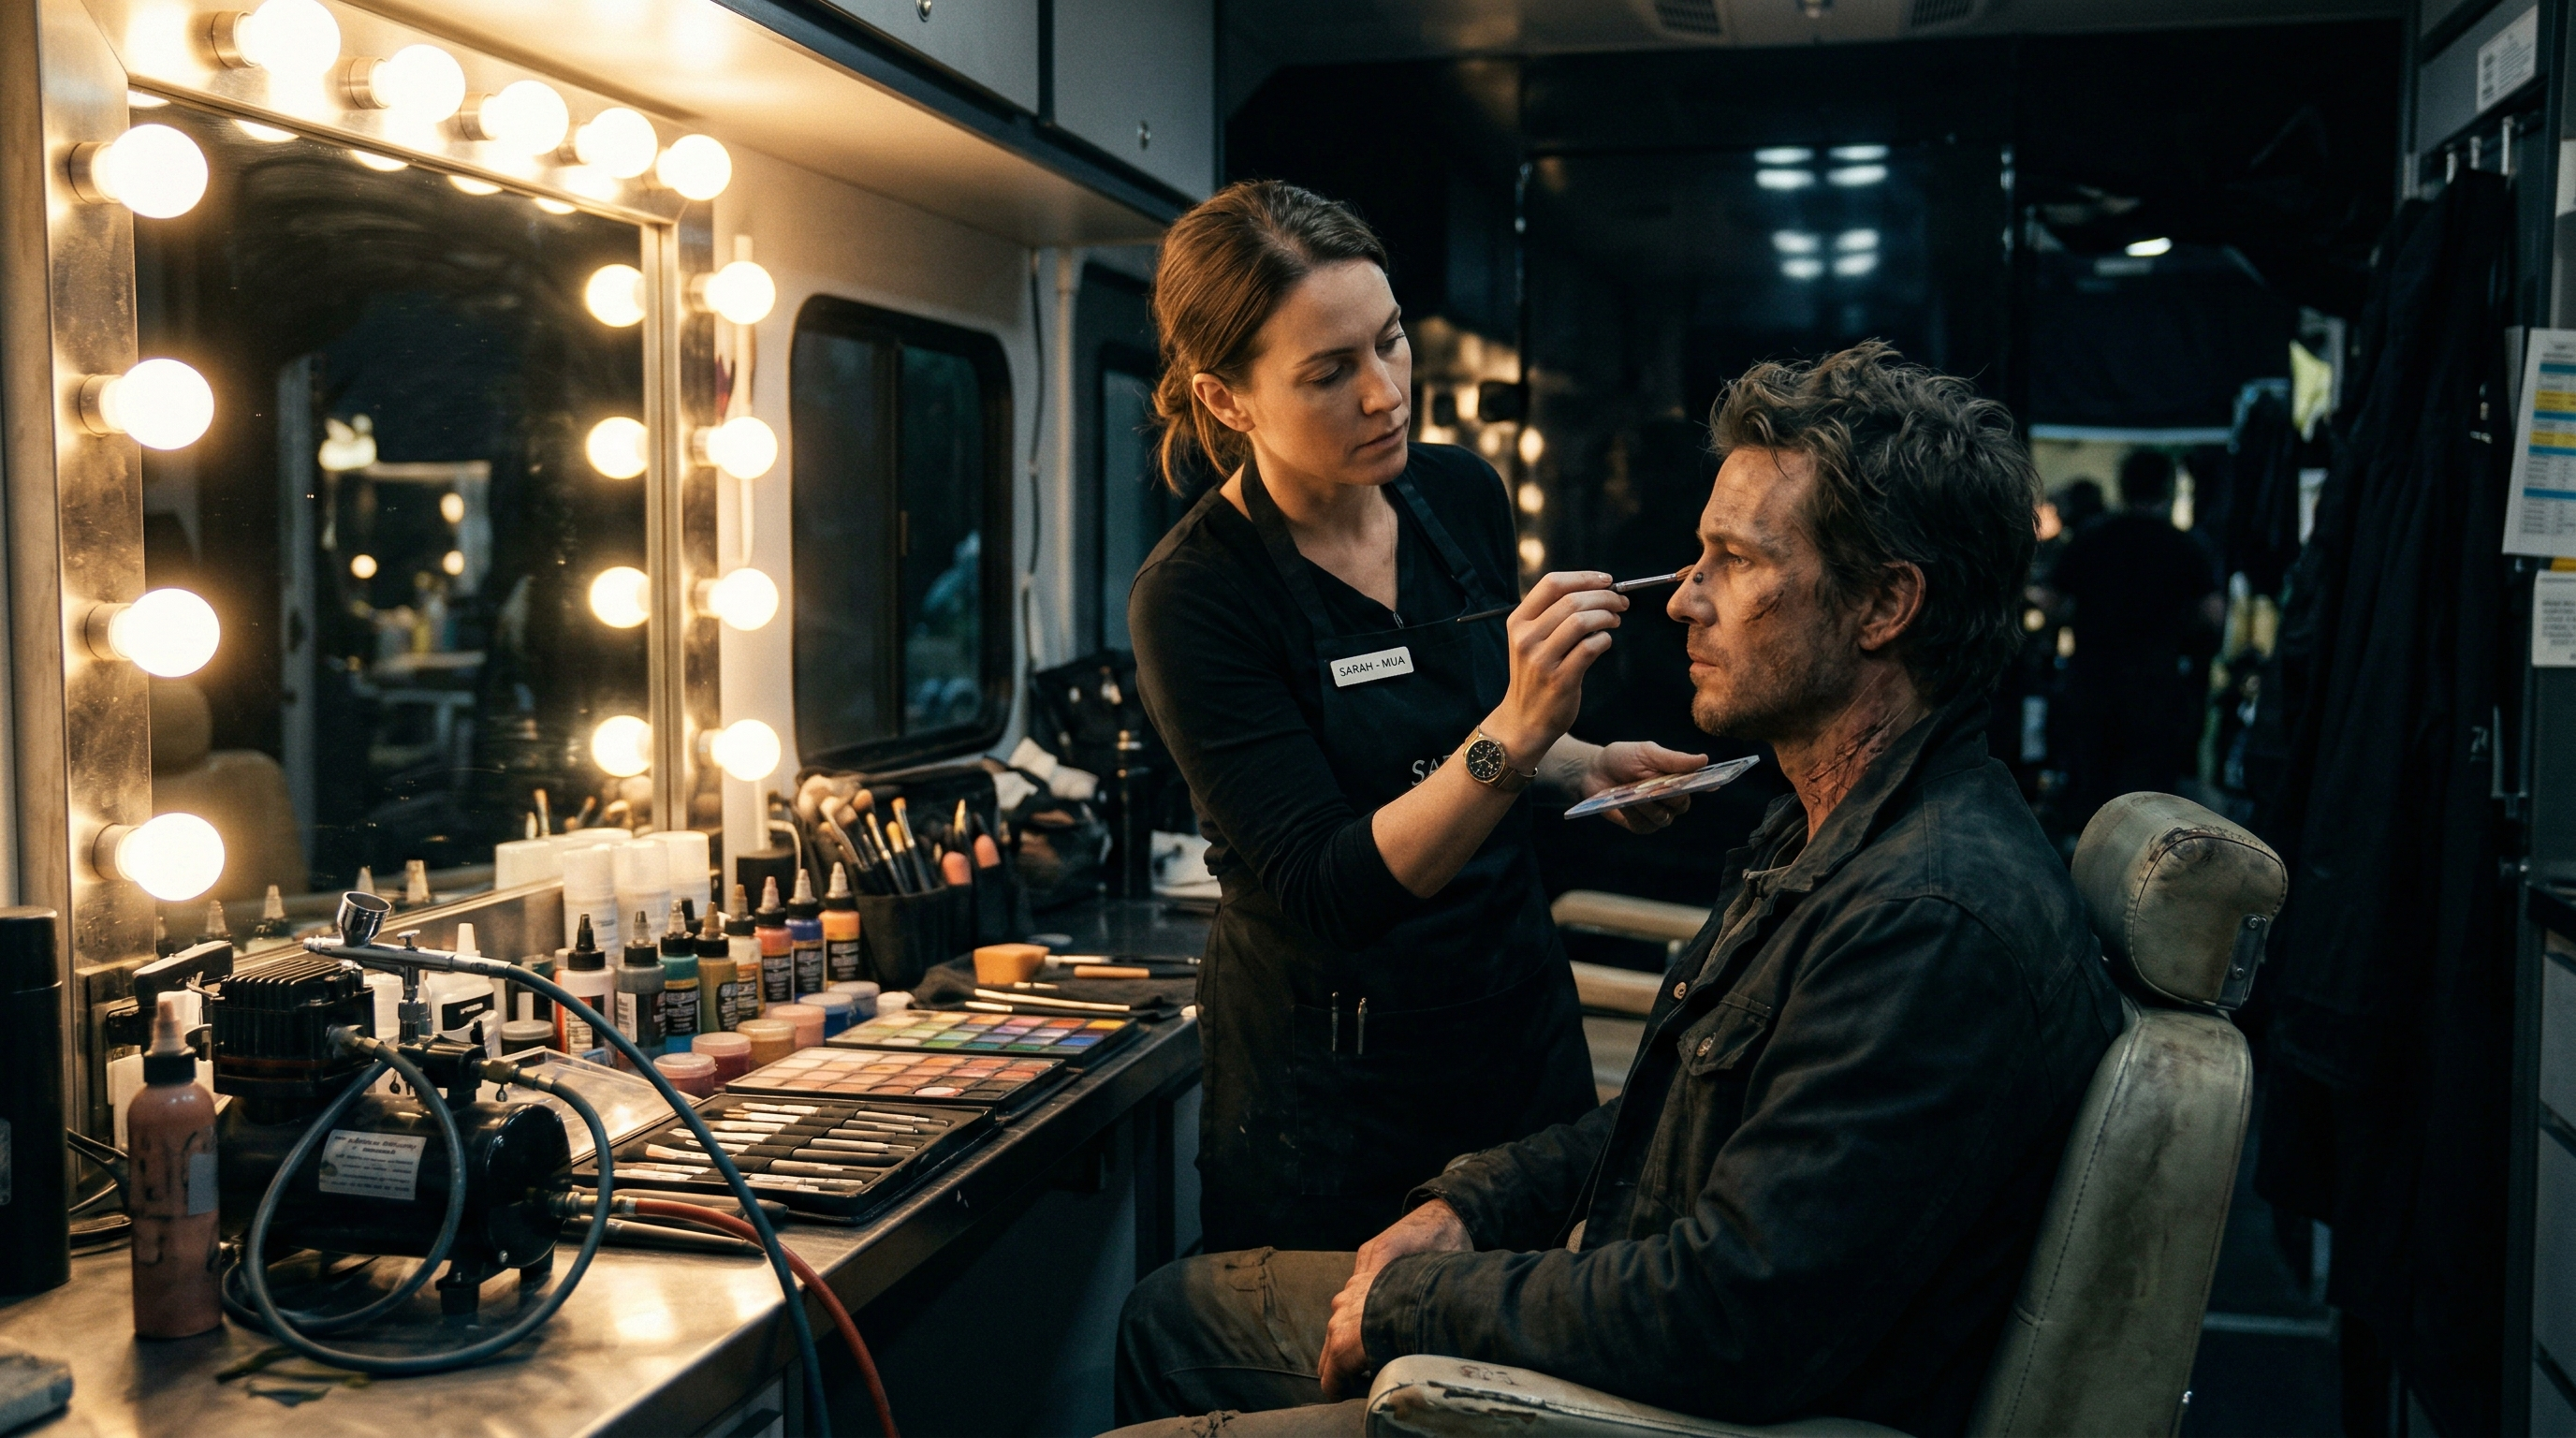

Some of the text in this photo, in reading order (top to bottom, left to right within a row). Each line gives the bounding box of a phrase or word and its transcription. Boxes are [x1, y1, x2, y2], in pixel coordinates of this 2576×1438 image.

[1339, 662, 1373, 676] SARAH
[1382, 656, 1405, 668] MUA
[1412, 755, 1451, 785] SA
